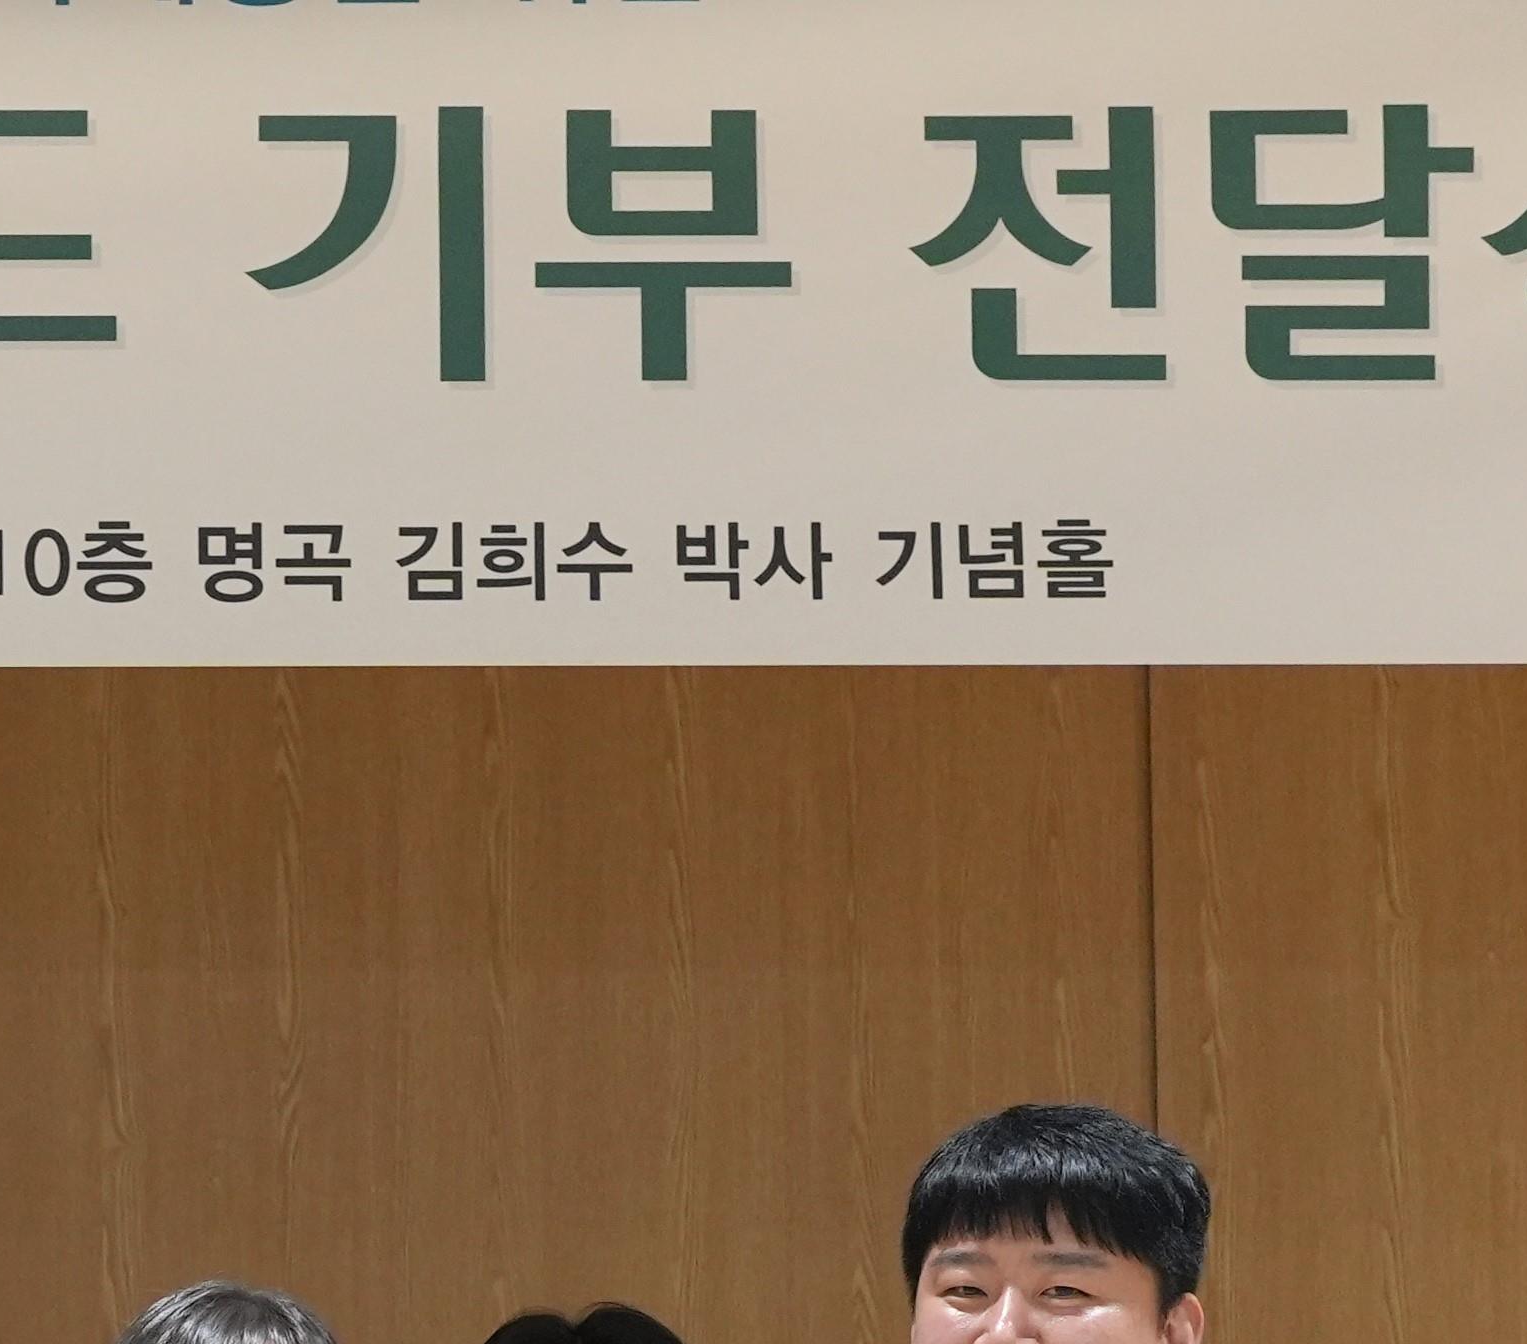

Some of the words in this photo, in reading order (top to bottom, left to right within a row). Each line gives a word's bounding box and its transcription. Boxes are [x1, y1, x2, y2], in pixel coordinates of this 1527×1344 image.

[246, 107, 792, 381] 기부
[198, 522, 351, 602] 명곡
[396, 522, 633, 601] 김희수
[677, 522, 832, 600] 박사
[877, 519, 1113, 599] 기념홀
